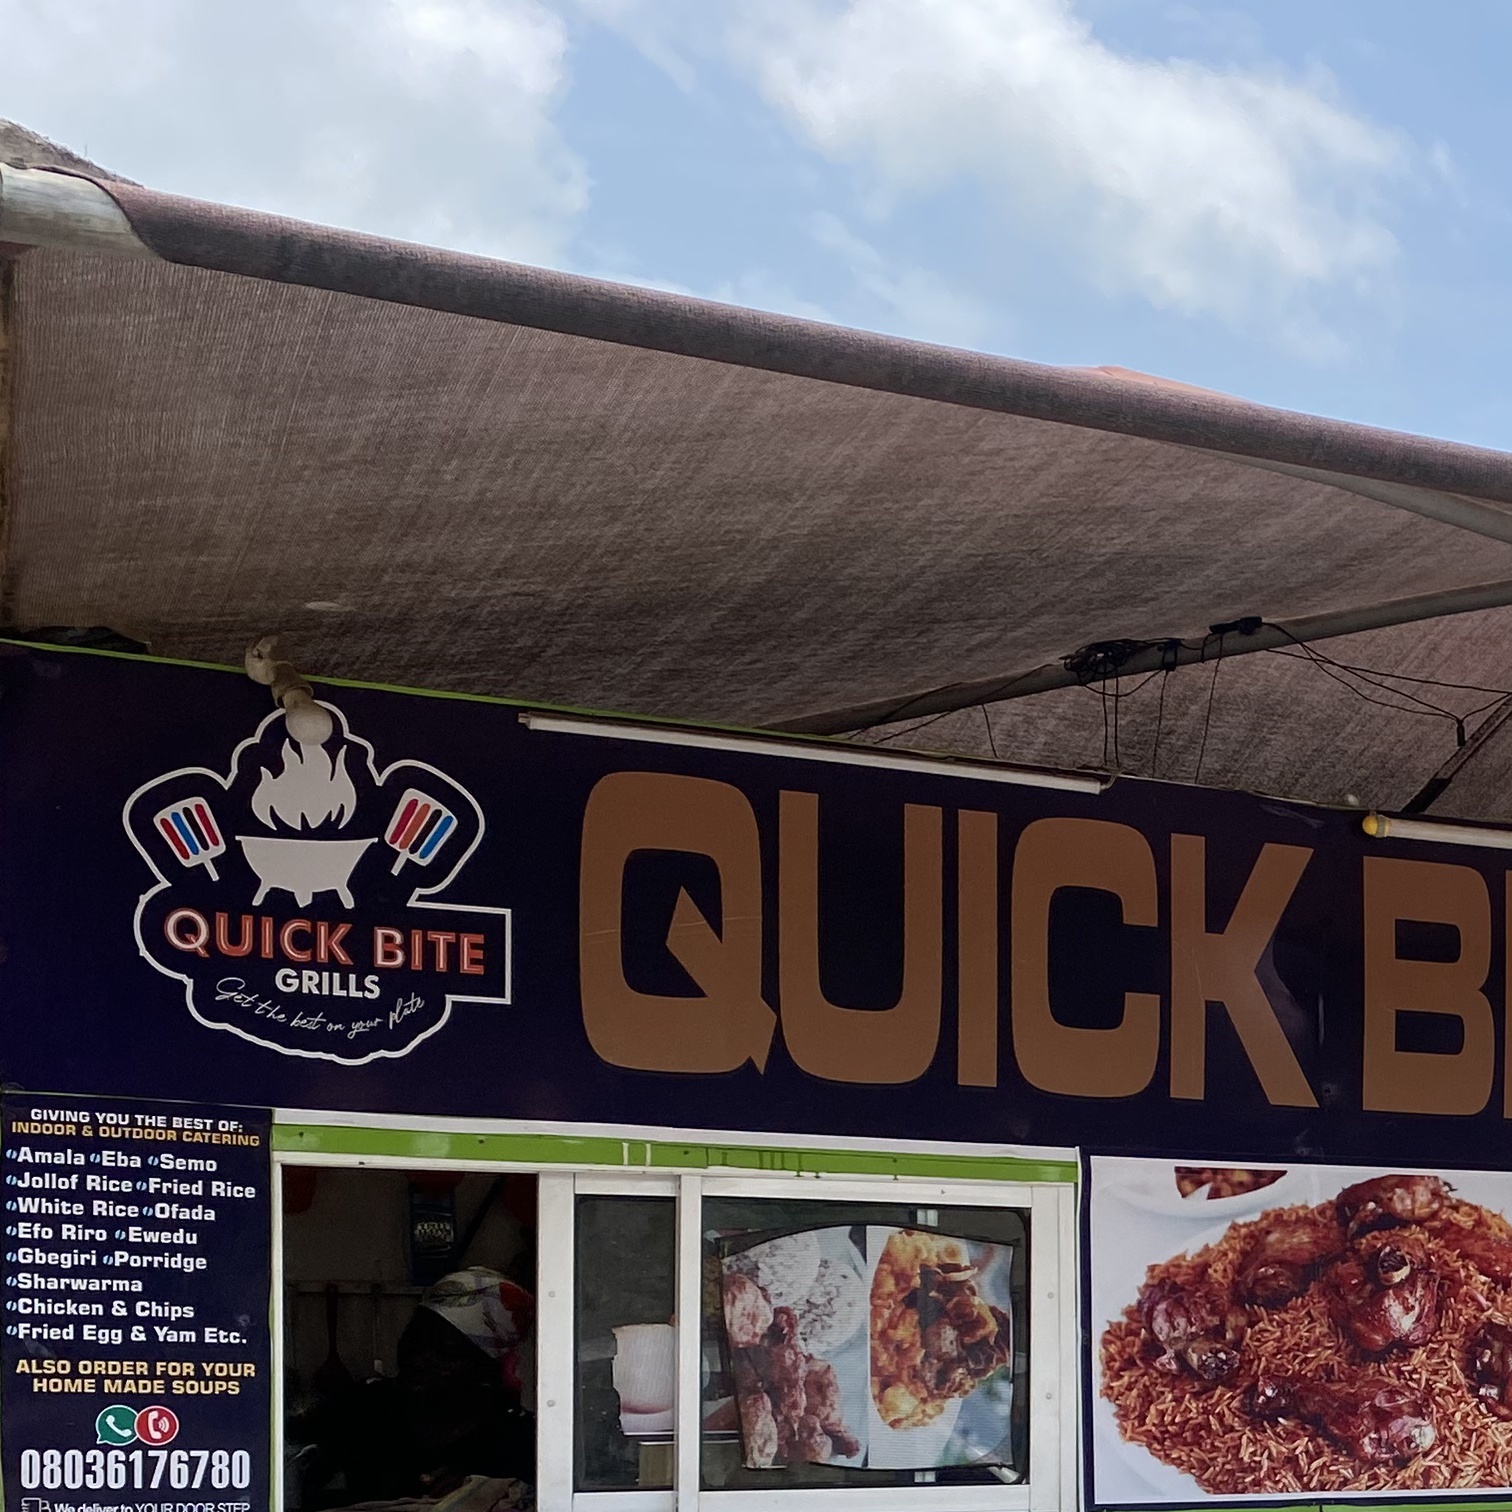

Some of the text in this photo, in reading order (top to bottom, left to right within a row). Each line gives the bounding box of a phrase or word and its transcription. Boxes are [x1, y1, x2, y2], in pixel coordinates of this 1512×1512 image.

[164, 907, 485, 975] QUICK BITE
[579, 771, 1320, 1108] QUICK
[275, 968, 381, 999] GRILLS
[215, 977, 425, 1039] Get the best on your plate
[31, 1109, 243, 1132] GIVING YOU THE BEST OF:
[12, 1121, 260, 1146] INDOOR & OUTDOOR CATERING
[17, 1147, 217, 1171] Amala Eba Semo
[17, 1172, 256, 1198] Jollof Rice Fried Rice
[17, 1197, 216, 1221] White Rice Ofada
[18, 1222, 198, 1244] Efo Riro Ewedu
[17, 1248, 207, 1272] Gbegiri Porridge
[17, 1273, 143, 1292] Sharwarma
[17, 1298, 194, 1321] Chicken & Chips
[18, 1323, 247, 1345] Fried Egg & Yam Etc.
[16, 1359, 256, 1378] ALSO ORDER FOR YOUR
[33, 1378, 240, 1395] HOME MADE SOUPS
[20, 1449, 250, 1490] 08036176780
